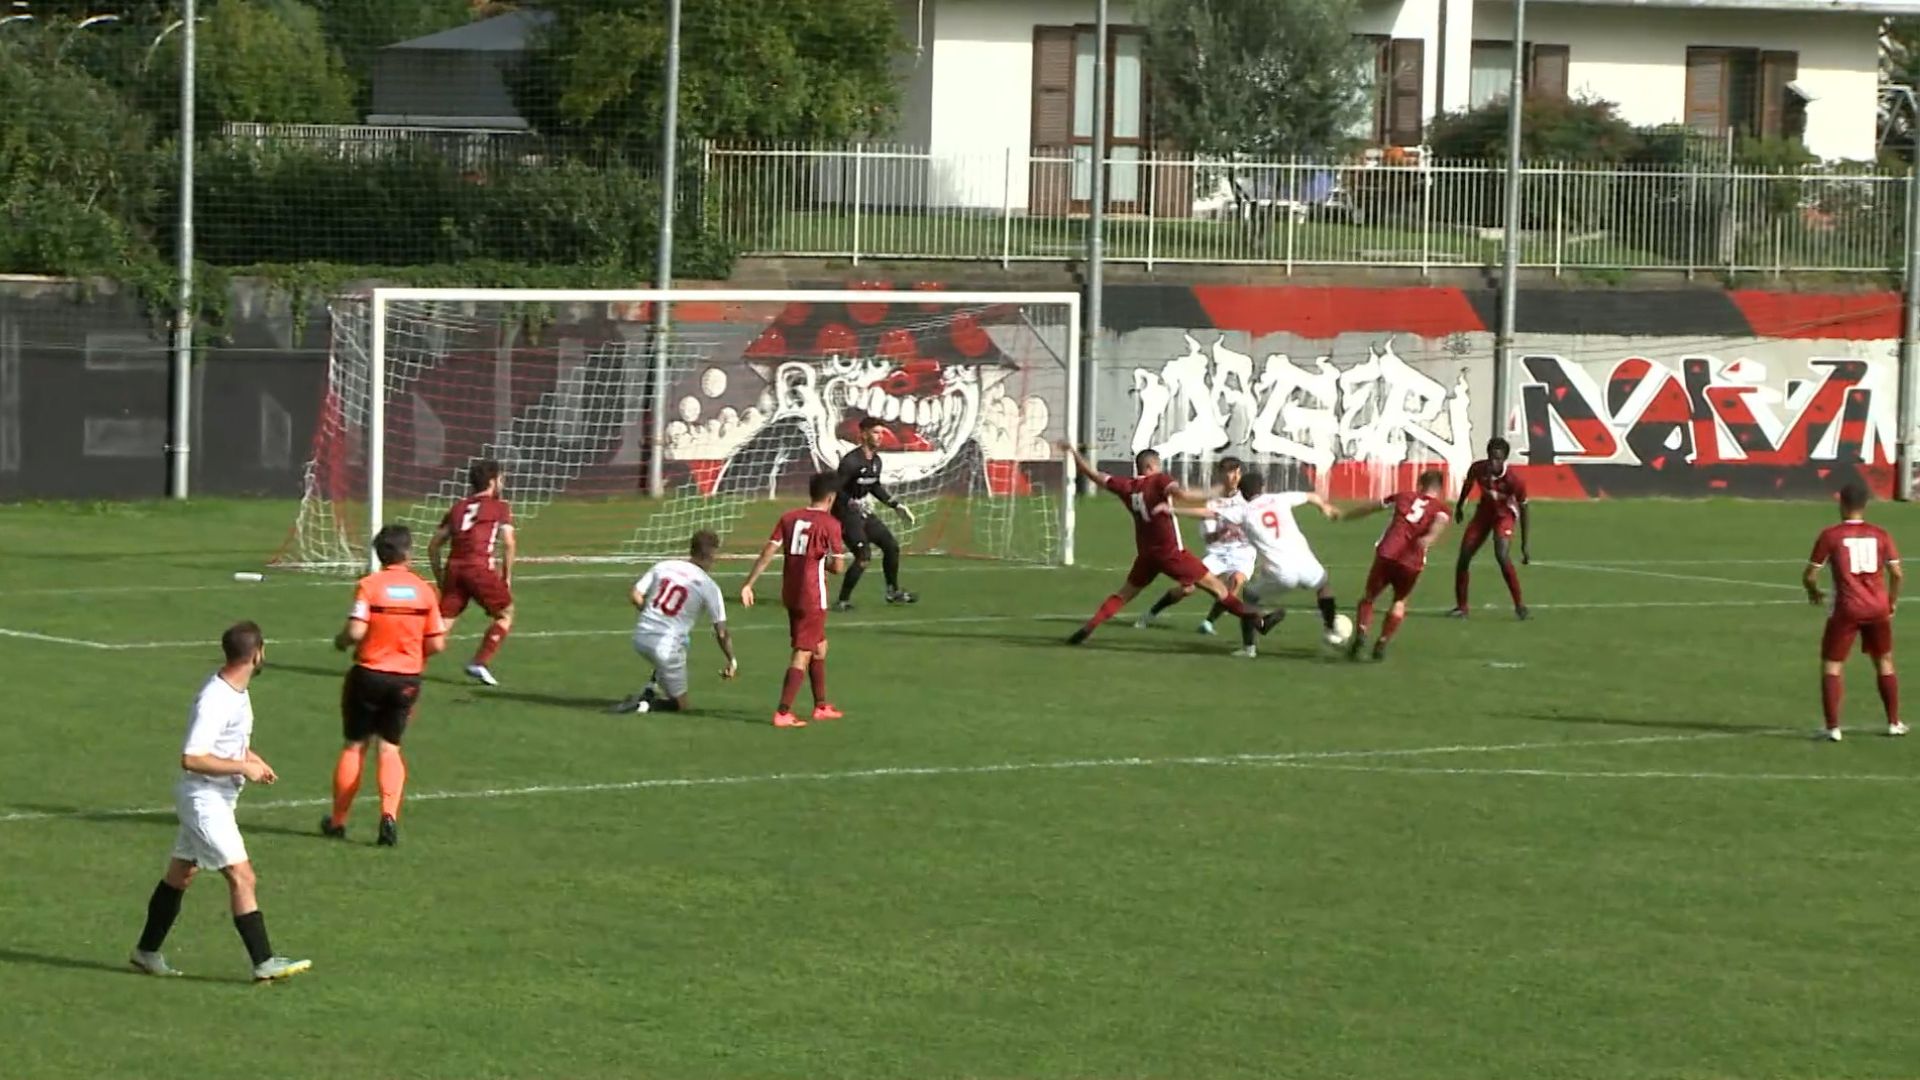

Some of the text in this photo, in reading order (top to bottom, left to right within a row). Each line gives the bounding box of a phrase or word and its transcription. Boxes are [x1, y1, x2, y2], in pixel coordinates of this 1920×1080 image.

[461, 502, 480, 531] 2
[1261, 511, 1280, 539] 9
[1405, 498, 1429, 523] 5
[790, 519, 812, 555] 6
[1842, 537, 1878, 574] 10
[653, 578, 689, 617] 10
